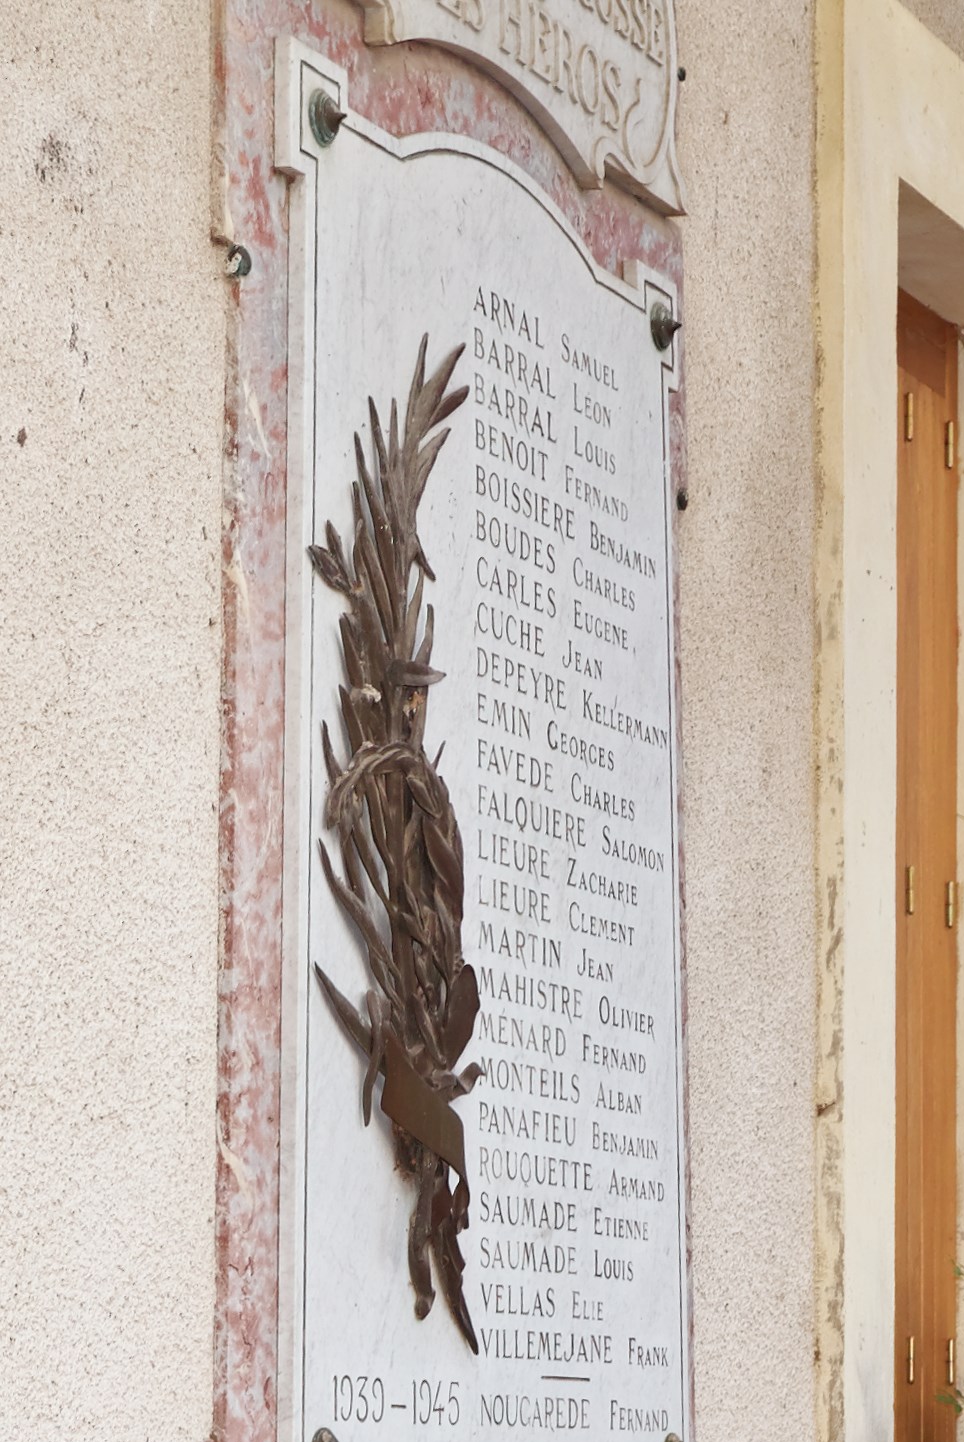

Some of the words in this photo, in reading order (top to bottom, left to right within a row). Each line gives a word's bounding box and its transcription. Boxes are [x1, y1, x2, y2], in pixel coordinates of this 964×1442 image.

[473, 286, 544, 349] ARNAL
[473, 327, 556, 399] BARRAL
[474, 372, 557, 443] BARRAL
[475, 418, 548, 481] BENOIT
[475, 464, 576, 545] BOISSIERE
[475, 509, 556, 574] BOUDES
[476, 556, 557, 618] CARLES
[476, 602, 545, 657] CUCHE
[477, 647, 567, 715] DEPEYRE
[477, 693, 531, 742] EMIN
[477, 738, 554, 793] FAVEDE
[478, 784, 586, 851] FALQUIERE
[478, 829, 550, 885] LIEURE
[478, 875, 551, 927] LIEURE
[478, 920, 562, 969] MARTIN
[478, 966, 583, 1024] MAHISTRE
[479, 1009, 566, 1063] MÉNARD
[479, 1056, 581, 1104] MONTEILS
[479, 1101, 577, 1147] PANAFIEU
[479, 1146, 593, 1191] ROUQUETTE
[480, 1191, 577, 1232] SAUMADE
[480, 1237, 578, 1276] SAUMADE
[480, 1282, 556, 1318] VELLAS
[480, 1327, 613, 1364] VILLEMEJANE
